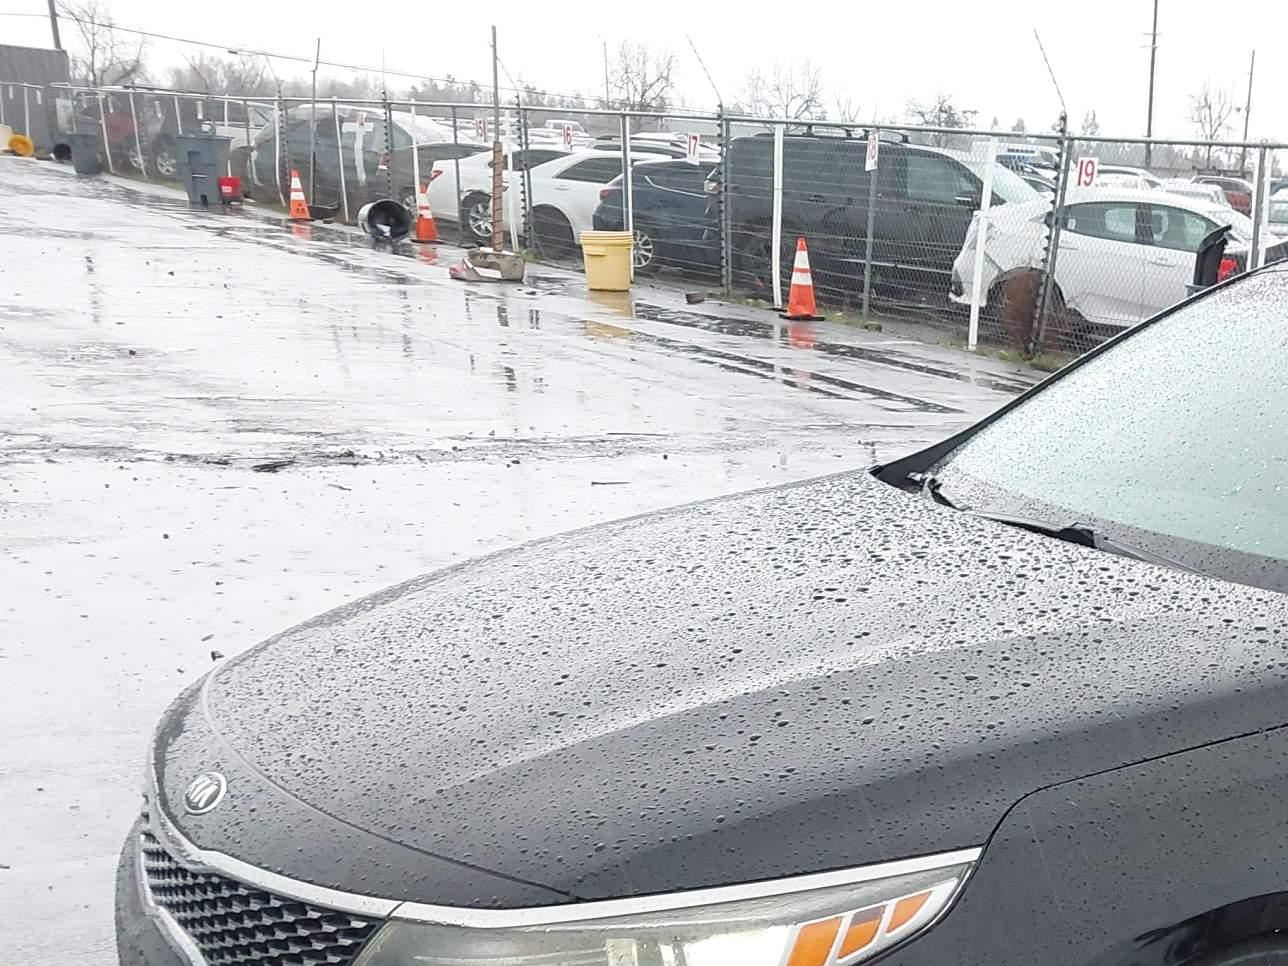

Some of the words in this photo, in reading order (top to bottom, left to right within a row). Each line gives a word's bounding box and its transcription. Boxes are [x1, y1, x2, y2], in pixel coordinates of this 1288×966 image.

[563, 125, 572, 145] 16
[688, 135, 698, 156] 17
[868, 135, 877, 160] 18
[1077, 159, 1095, 187] 19
